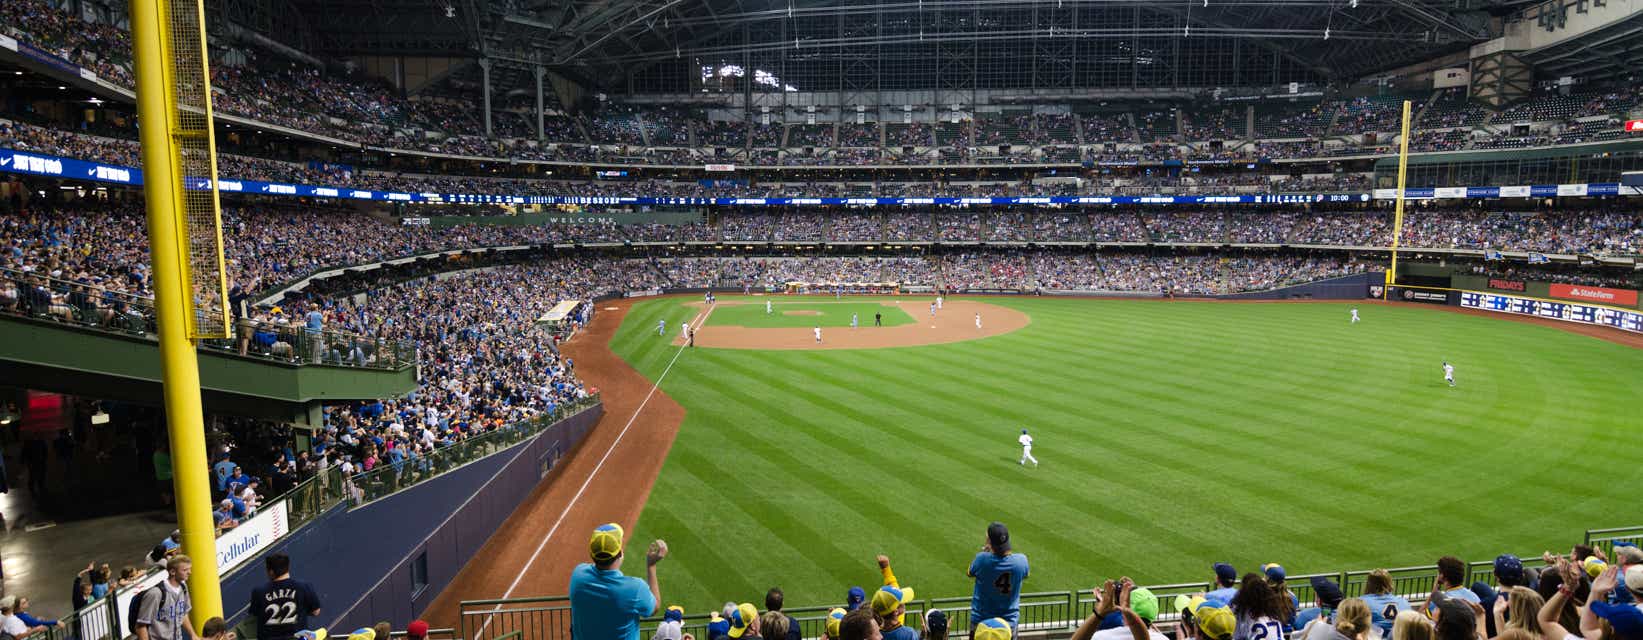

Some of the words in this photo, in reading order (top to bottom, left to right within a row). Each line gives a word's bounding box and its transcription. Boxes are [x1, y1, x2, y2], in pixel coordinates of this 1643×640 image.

[216, 533, 260, 568] Cellular
[993, 572, 1012, 594] 4
[265, 588, 297, 601] GARZA
[265, 601, 298, 625] 22
[1251, 620, 1283, 640] 27
